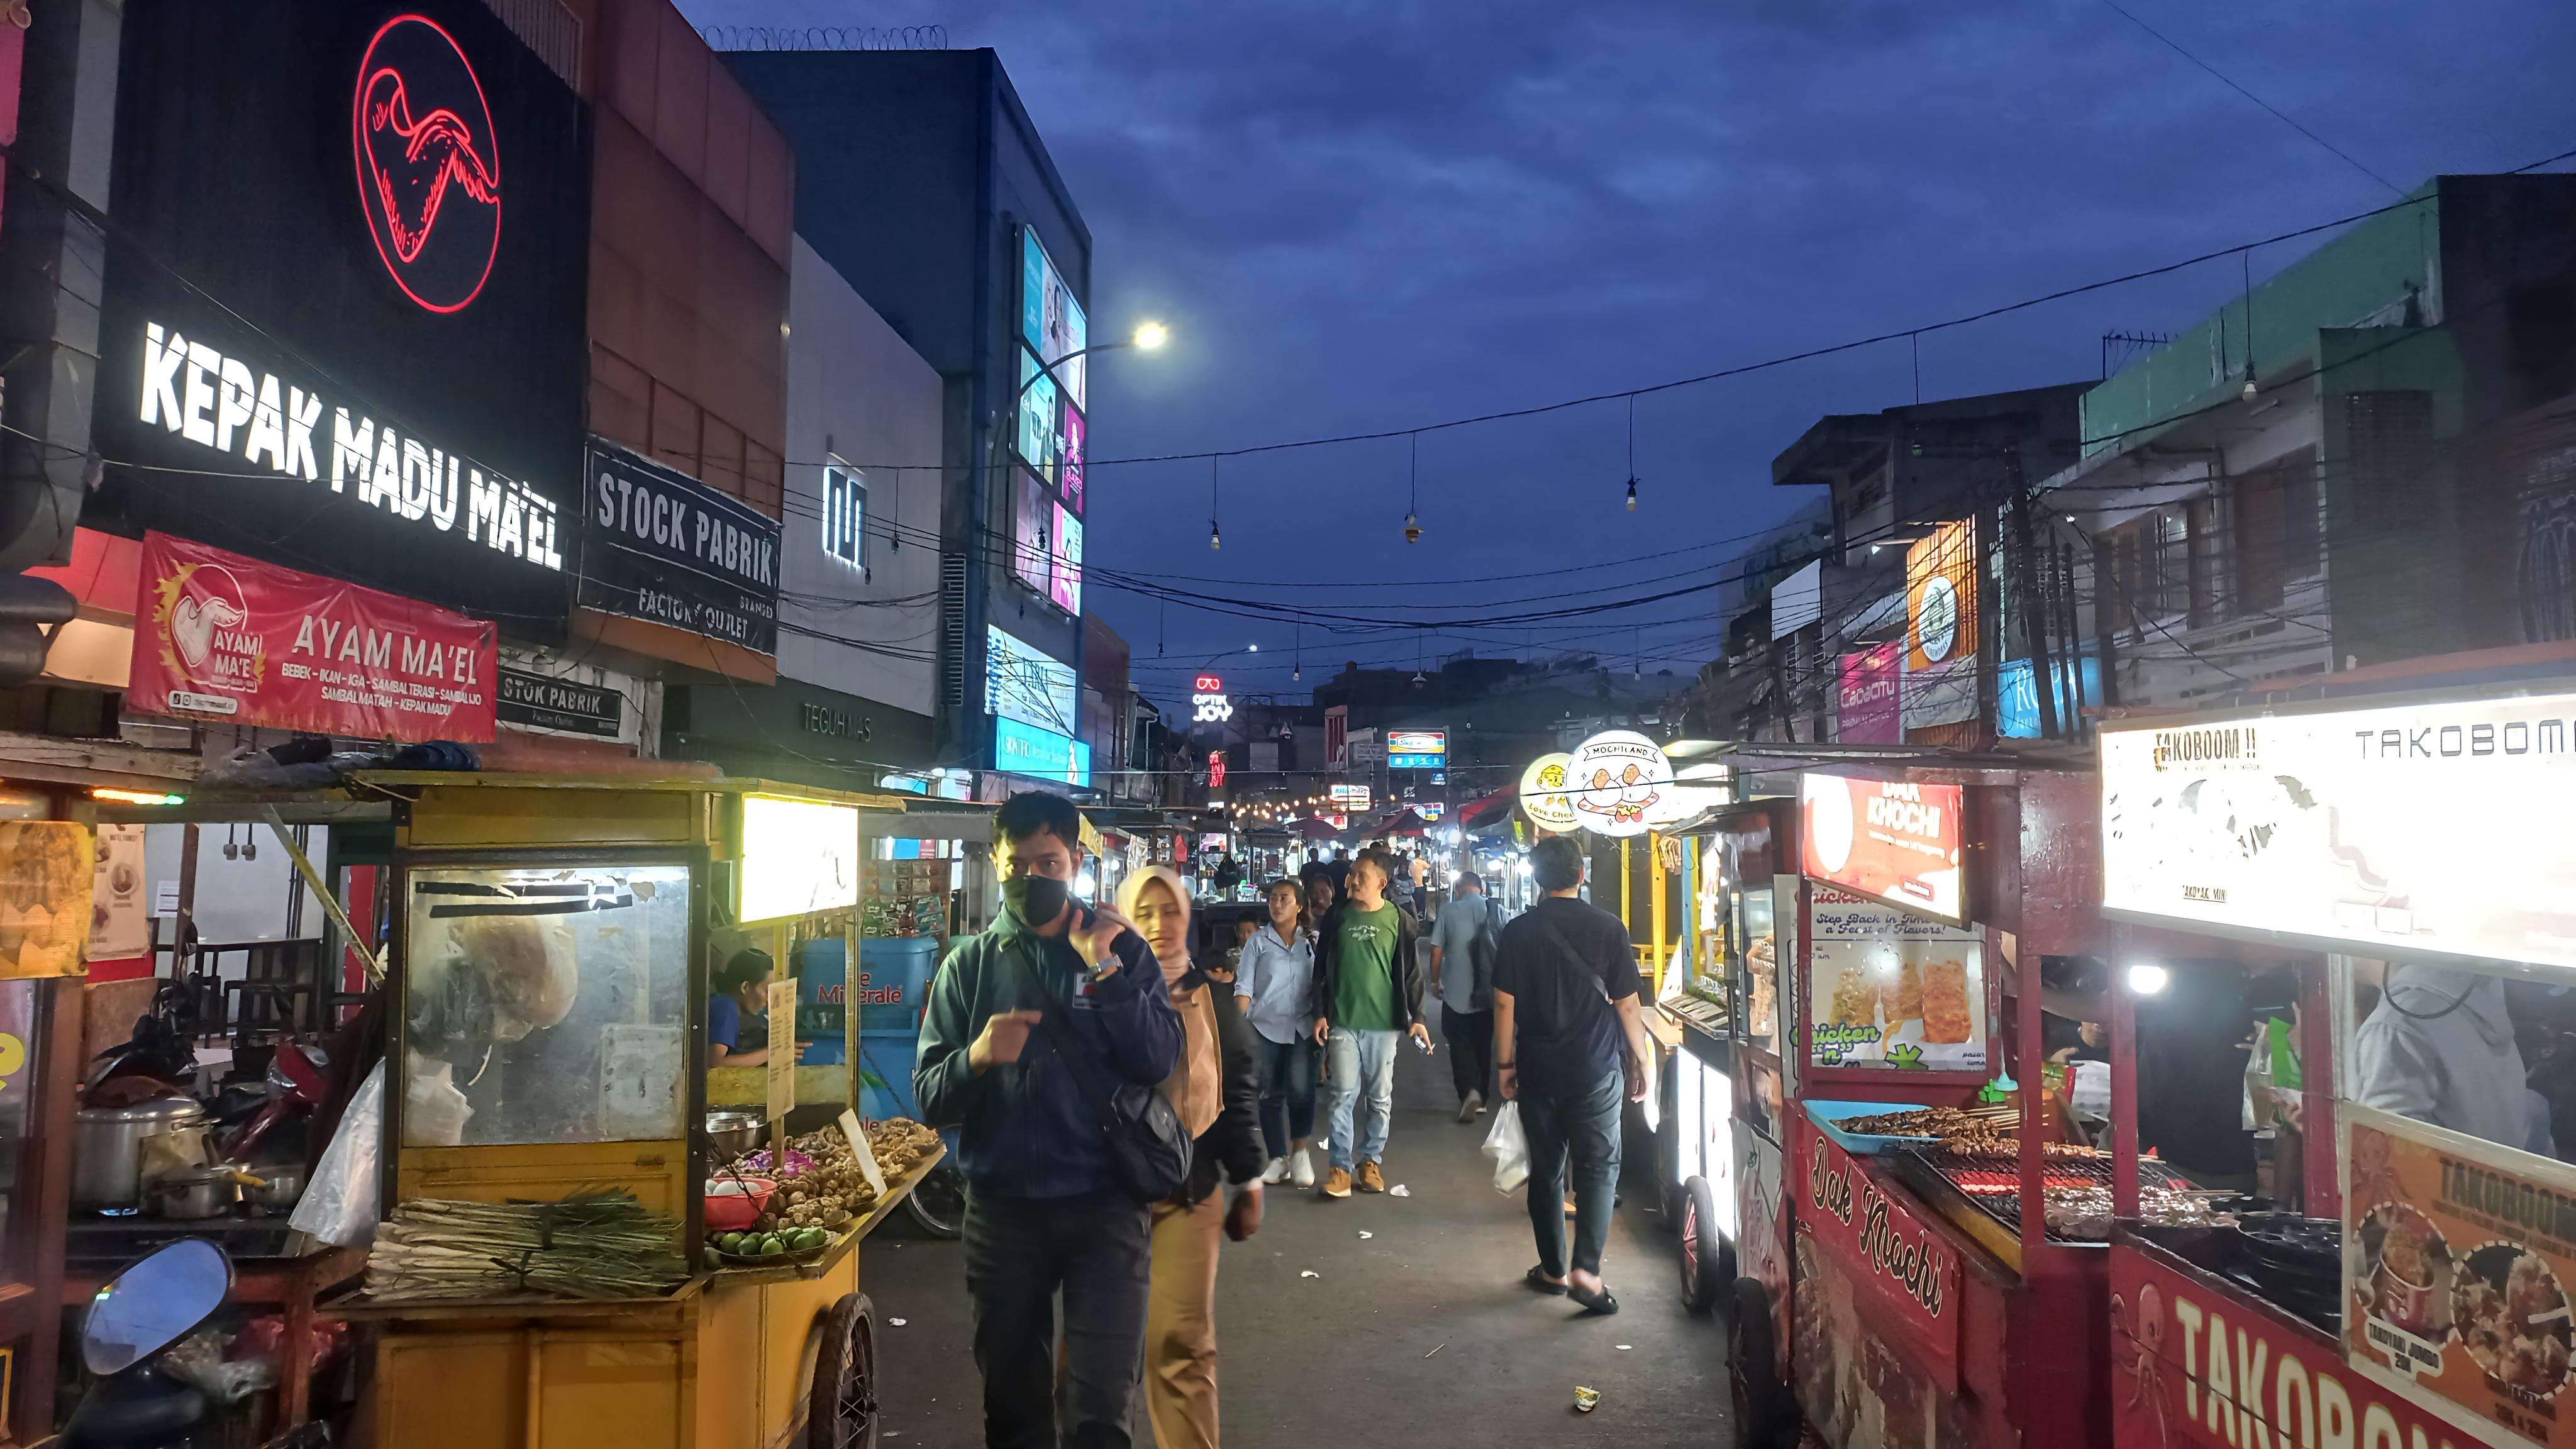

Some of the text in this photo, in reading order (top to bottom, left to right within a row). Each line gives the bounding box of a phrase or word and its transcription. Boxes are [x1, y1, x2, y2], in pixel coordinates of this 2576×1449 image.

[140, 321, 322, 482] KEPAK
[330, 407, 459, 531] MADU
[599, 472, 772, 587] STOCK PABRIK
[214, 630, 258, 655] AYAM
[292, 614, 478, 685] AYAM MA'EL
[282, 662, 311, 680] BEBEK
[319, 668, 341, 684] IKAN
[348, 674, 365, 689] IGA
[371, 679, 408, 695] SAMBAL
[408, 683, 435, 699] TERASI
[440, 688, 469, 705] SAMBAL
[504, 677, 601, 713] STOK PABRIK
[321, 686, 452, 716] SAMBAL MATAH KEPAK MADU
[1192, 694, 1227, 705] OPTIK
[1192, 705, 1233, 721] JOY
[805, 704, 845, 735] TEGUH
[1593, 746, 1648, 756] MOCHILAND
[2153, 729, 2240, 761] TAKOBOOM
[2356, 719, 2576, 759] TAKOBOM
[1867, 796, 1941, 839] KHOCHI
[1816, 913, 1842, 926] Step
[1846, 913, 1881, 926] Back
[1885, 915, 1897, 924] in
[1826, 926, 1834, 934] a
[1893, 923, 1946, 935] Flavors!
[818, 985, 902, 1004] Mierale
[1812, 1138, 1942, 1318] Dak Khochi
